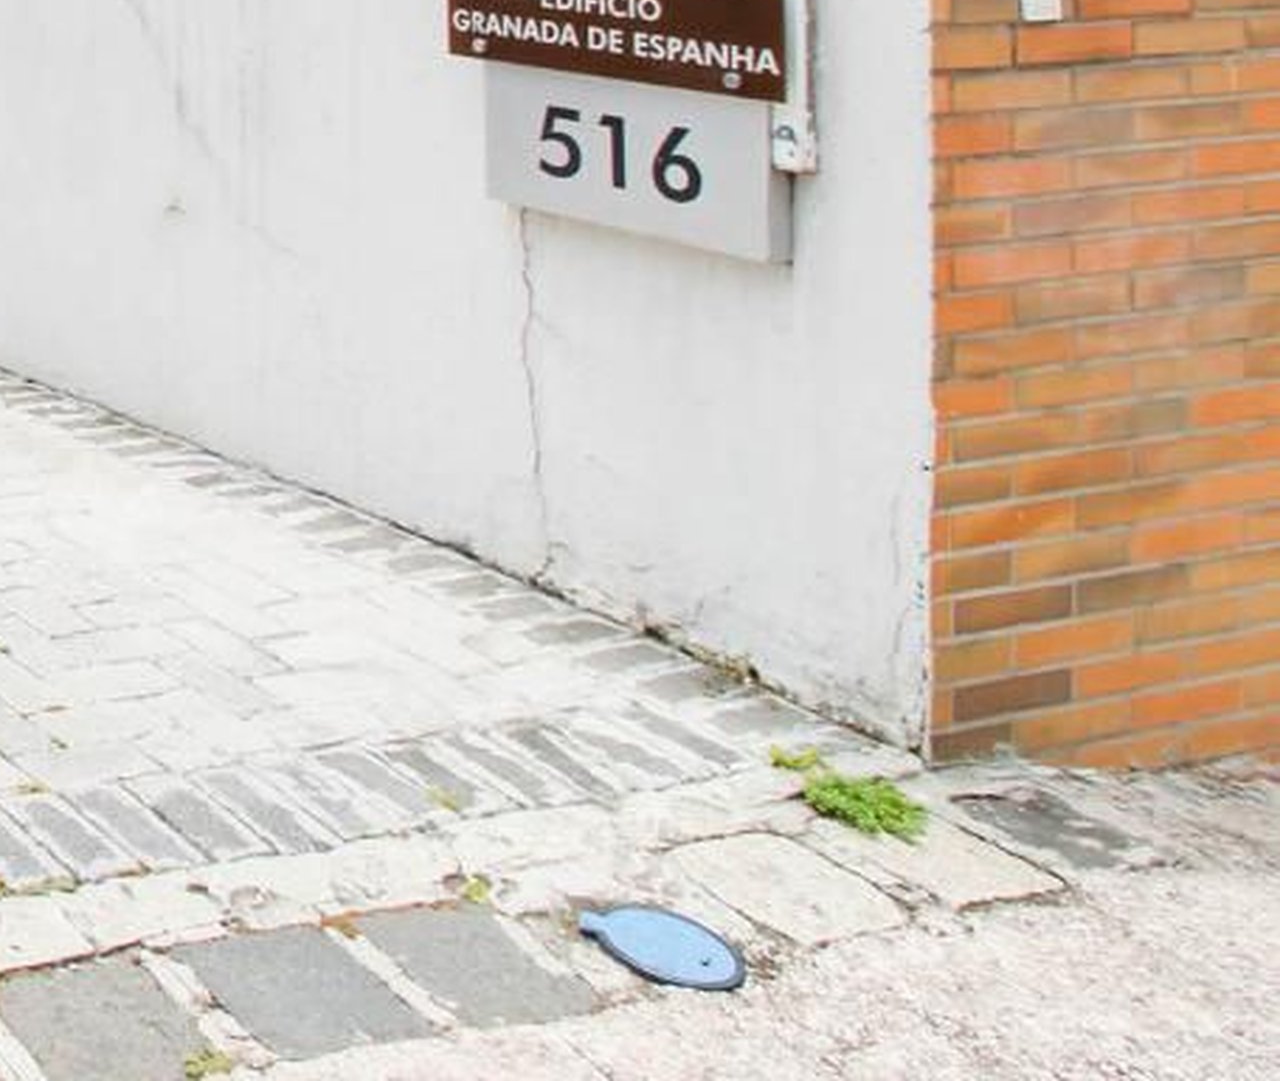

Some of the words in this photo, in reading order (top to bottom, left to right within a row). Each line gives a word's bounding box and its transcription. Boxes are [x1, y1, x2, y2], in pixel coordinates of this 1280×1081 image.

[452, 9, 580, 47] GRANADA
[587, 26, 625, 54] DE
[633, 32, 781, 76] ESPANHA
[540, 105, 703, 203] 516
